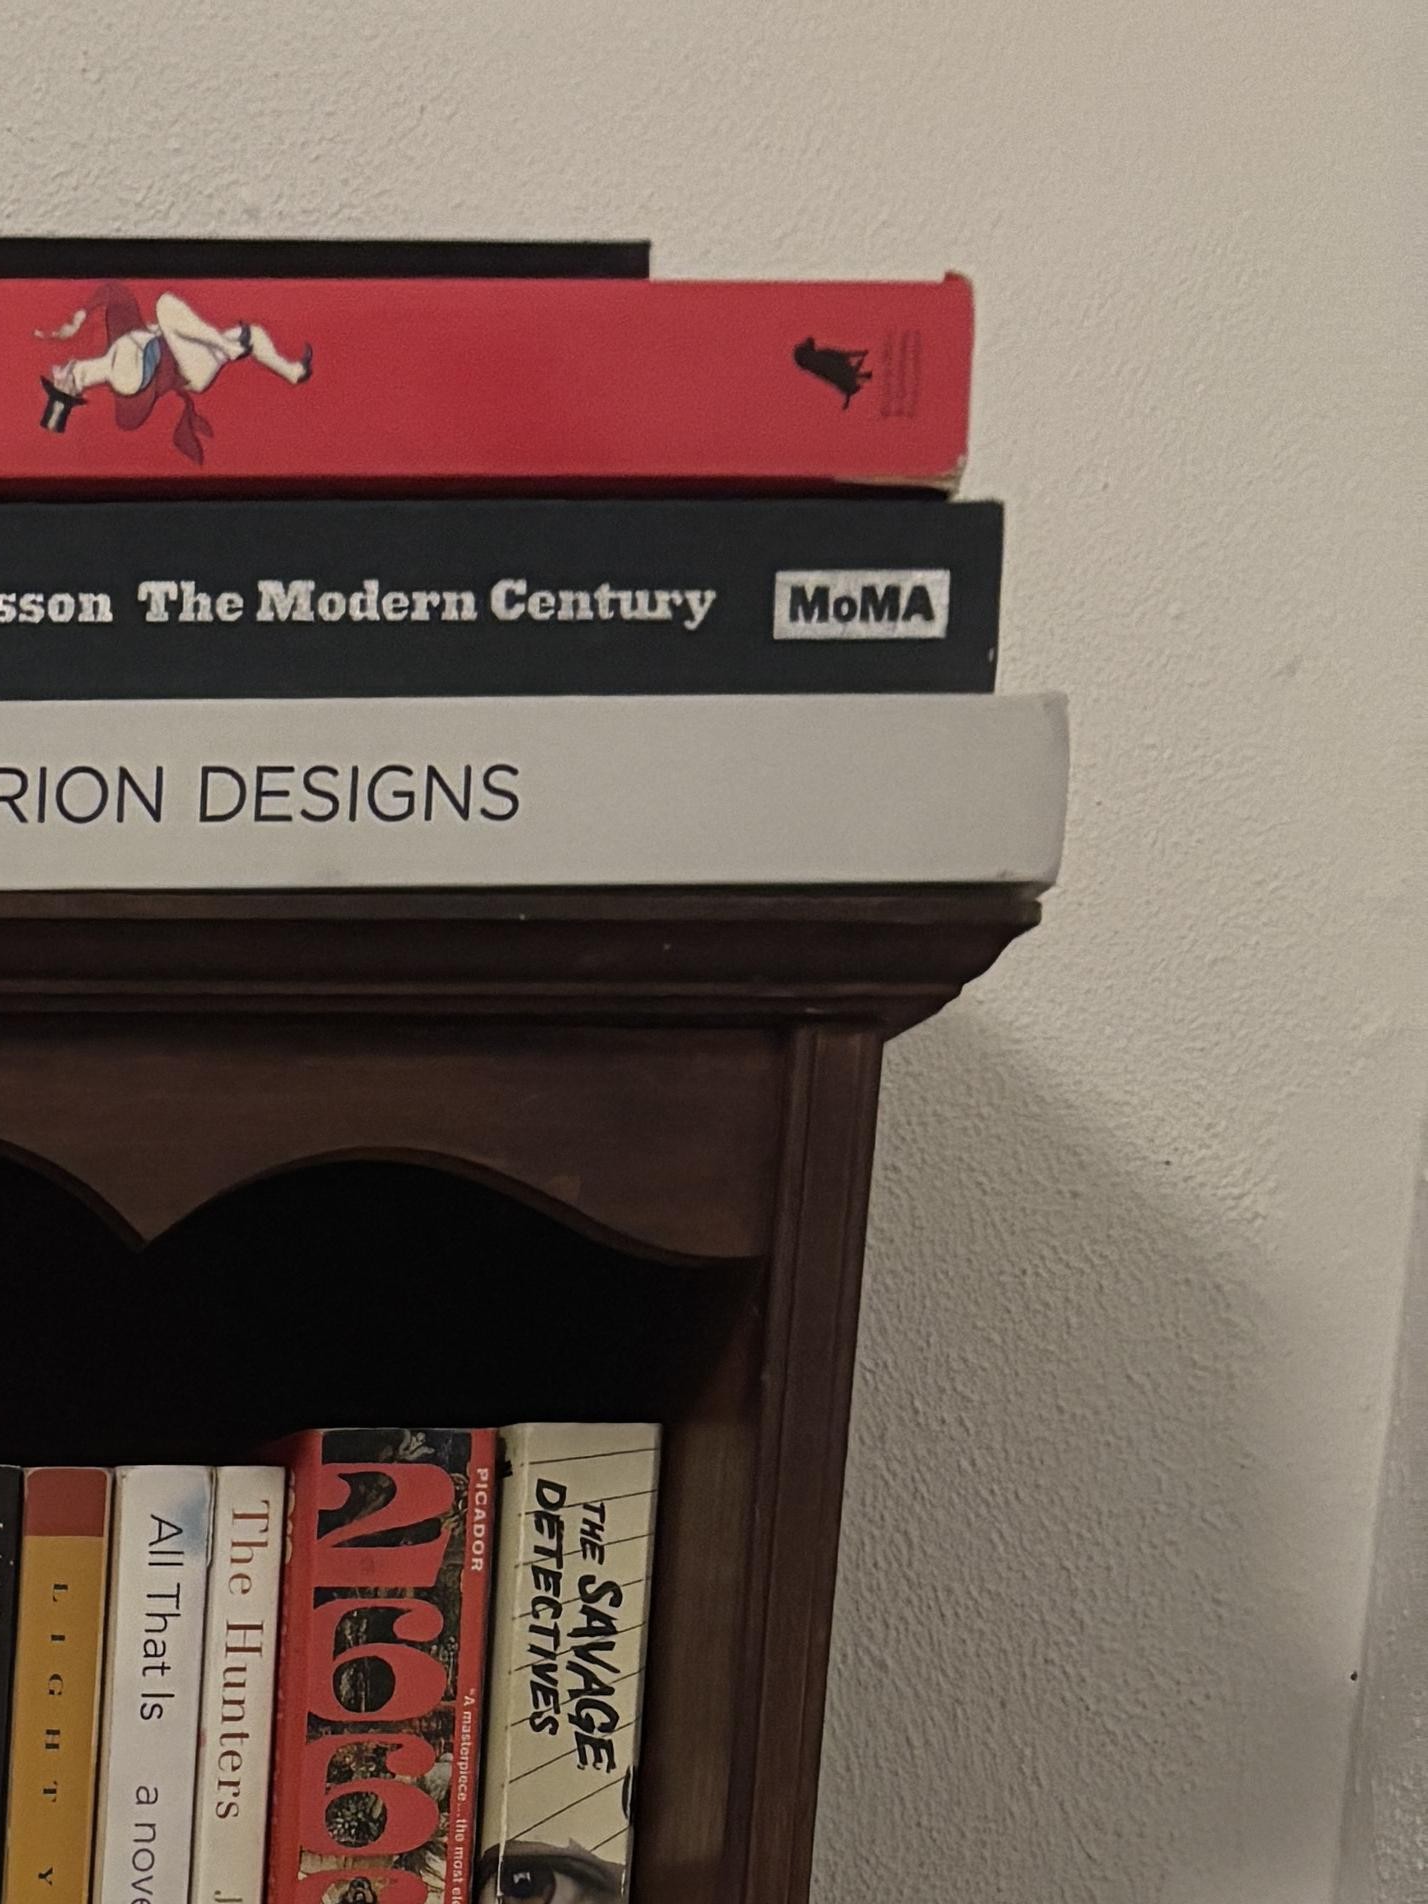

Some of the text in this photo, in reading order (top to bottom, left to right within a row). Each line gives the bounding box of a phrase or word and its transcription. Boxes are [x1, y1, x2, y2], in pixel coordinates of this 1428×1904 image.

[137, 582, 244, 624] The
[257, 580, 479, 622] Modern
[490, 578, 717, 631] Century
[789, 584, 936, 624] MoMA
[199, 763, 522, 825] DESIGNS
[140, 1515, 183, 1721] All That Is
[528, 1479, 567, 1736] DETECTIVES
[566, 1502, 623, 1773] THE SAVAGE
